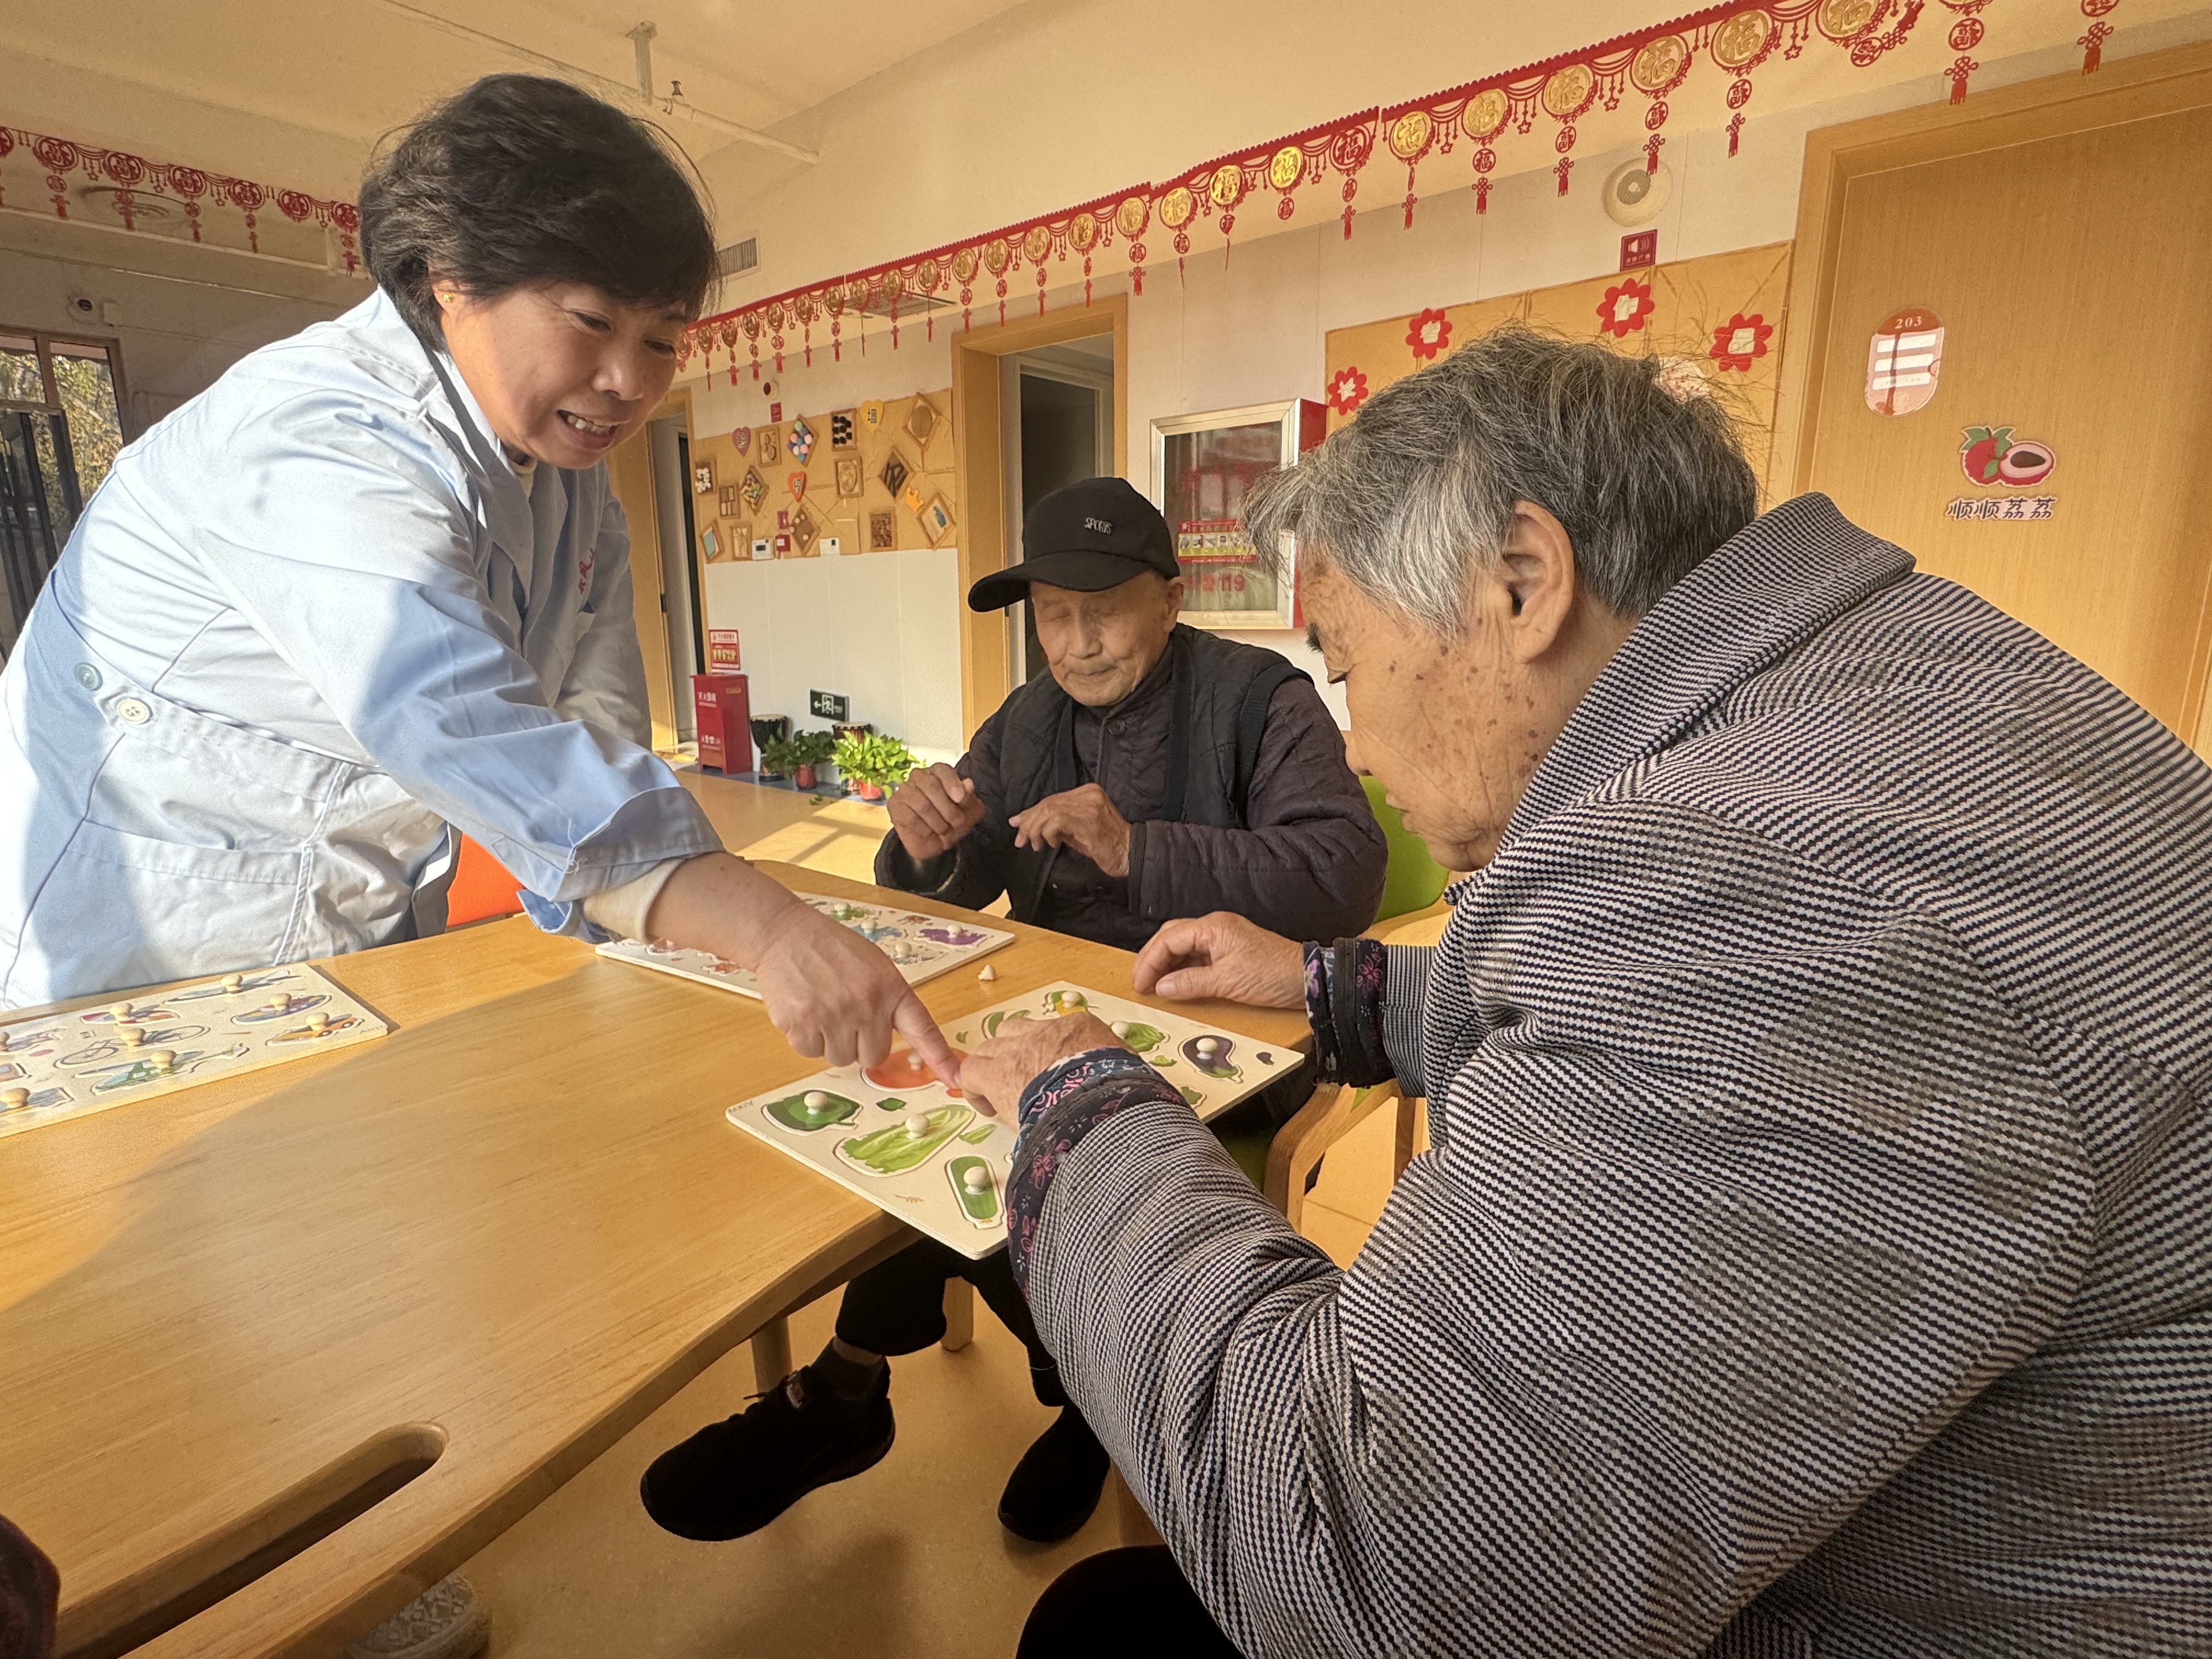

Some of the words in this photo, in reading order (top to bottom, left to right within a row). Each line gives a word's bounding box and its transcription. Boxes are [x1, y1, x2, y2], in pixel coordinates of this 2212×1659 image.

[1895, 316, 1922, 329] 203
[1947, 498, 2056, 520] 顺顺荔荔
[1084, 517, 1112, 535] SPORTS
